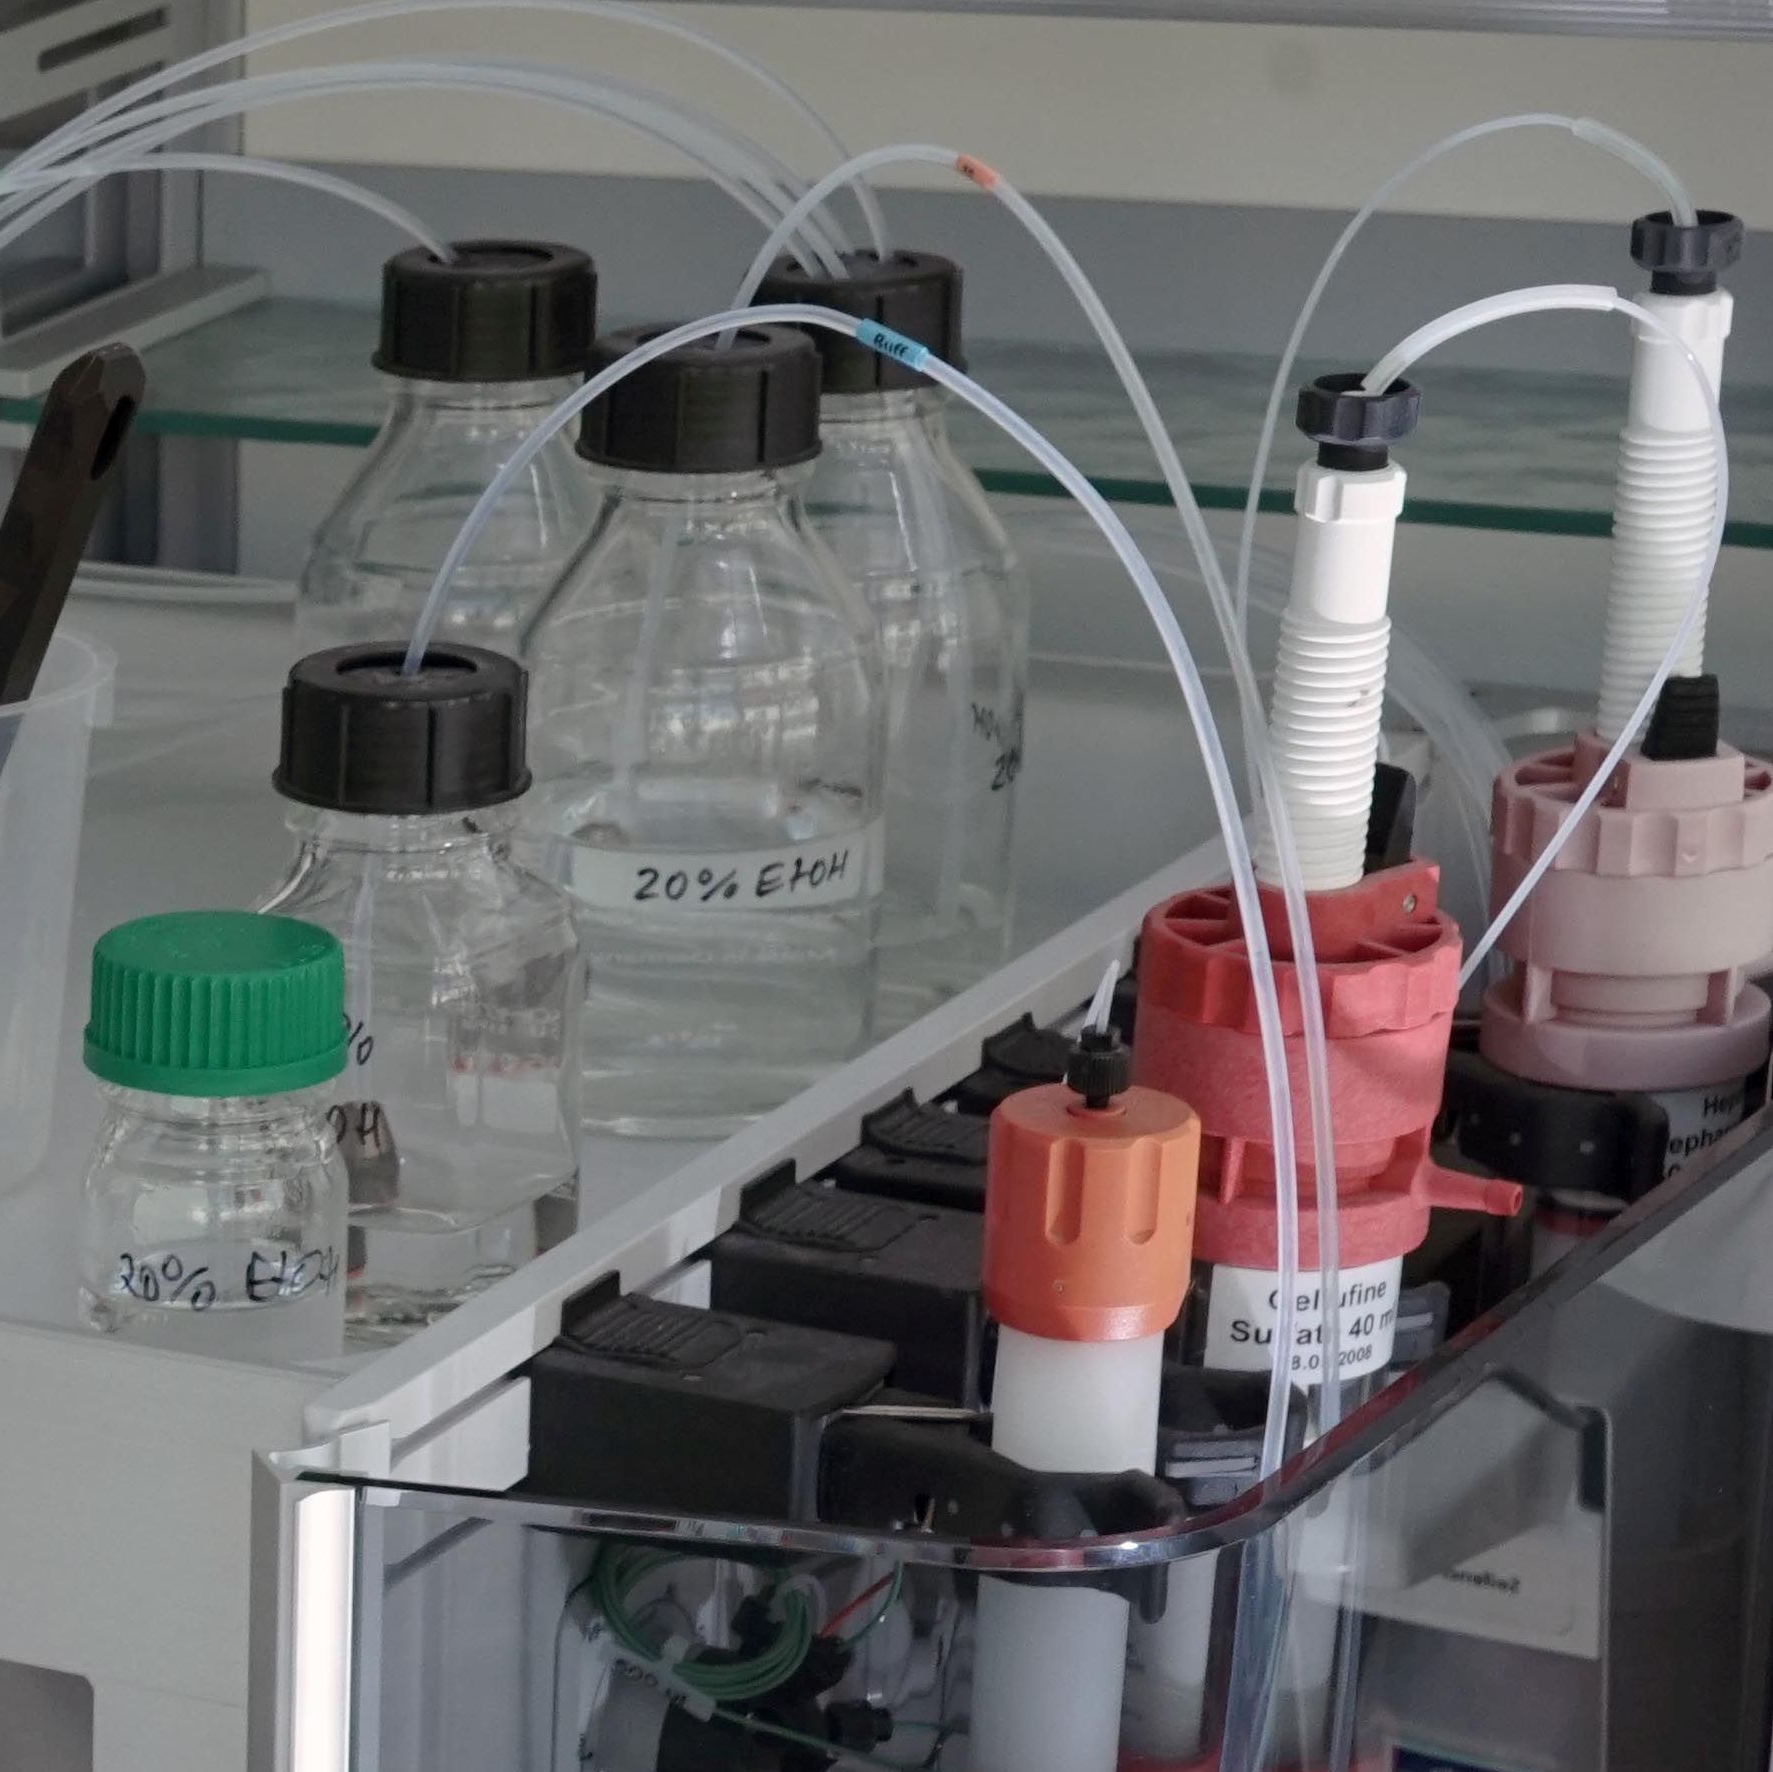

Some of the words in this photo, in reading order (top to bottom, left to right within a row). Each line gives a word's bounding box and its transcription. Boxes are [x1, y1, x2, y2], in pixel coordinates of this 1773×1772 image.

[634, 866, 738, 902] 20%
[754, 850, 848, 899] EtOH
[120, 1253, 216, 1312] 20%
[1348, 1313, 1375, 1338] 40
